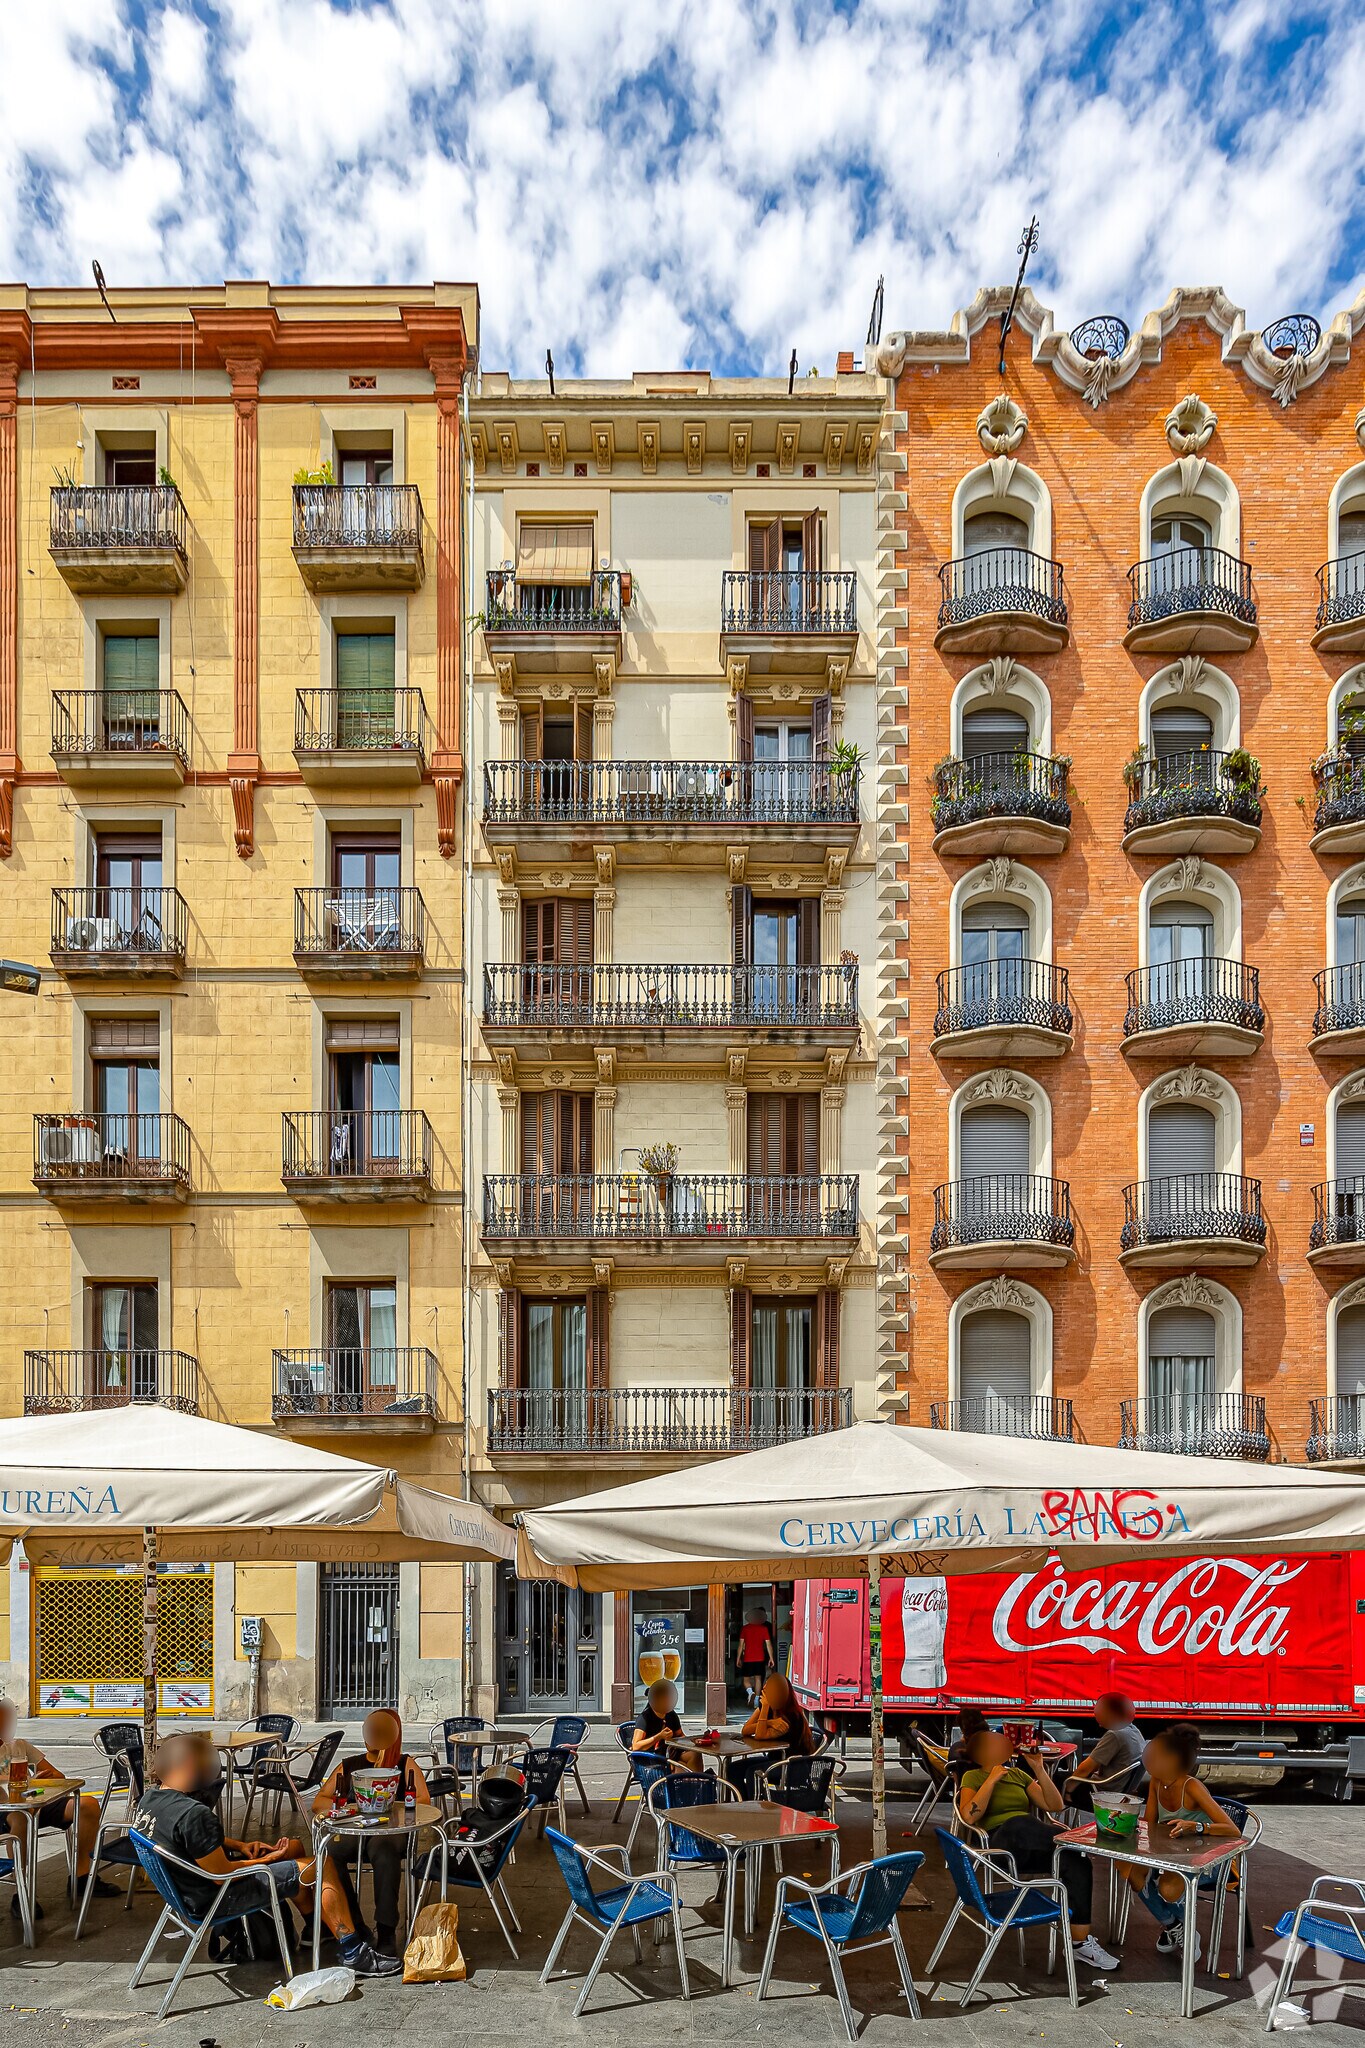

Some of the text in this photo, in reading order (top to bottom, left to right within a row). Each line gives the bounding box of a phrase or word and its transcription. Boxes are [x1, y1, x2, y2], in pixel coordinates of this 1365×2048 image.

[779, 1507, 988, 1548] CERVECERÍA
[1003, 1506, 1046, 1536] LA
[903, 1587, 947, 1613] Coca-Cola
[992, 1557, 1309, 1656] Coca-Cola
[660, 1634, 680, 1645] 3,5€
